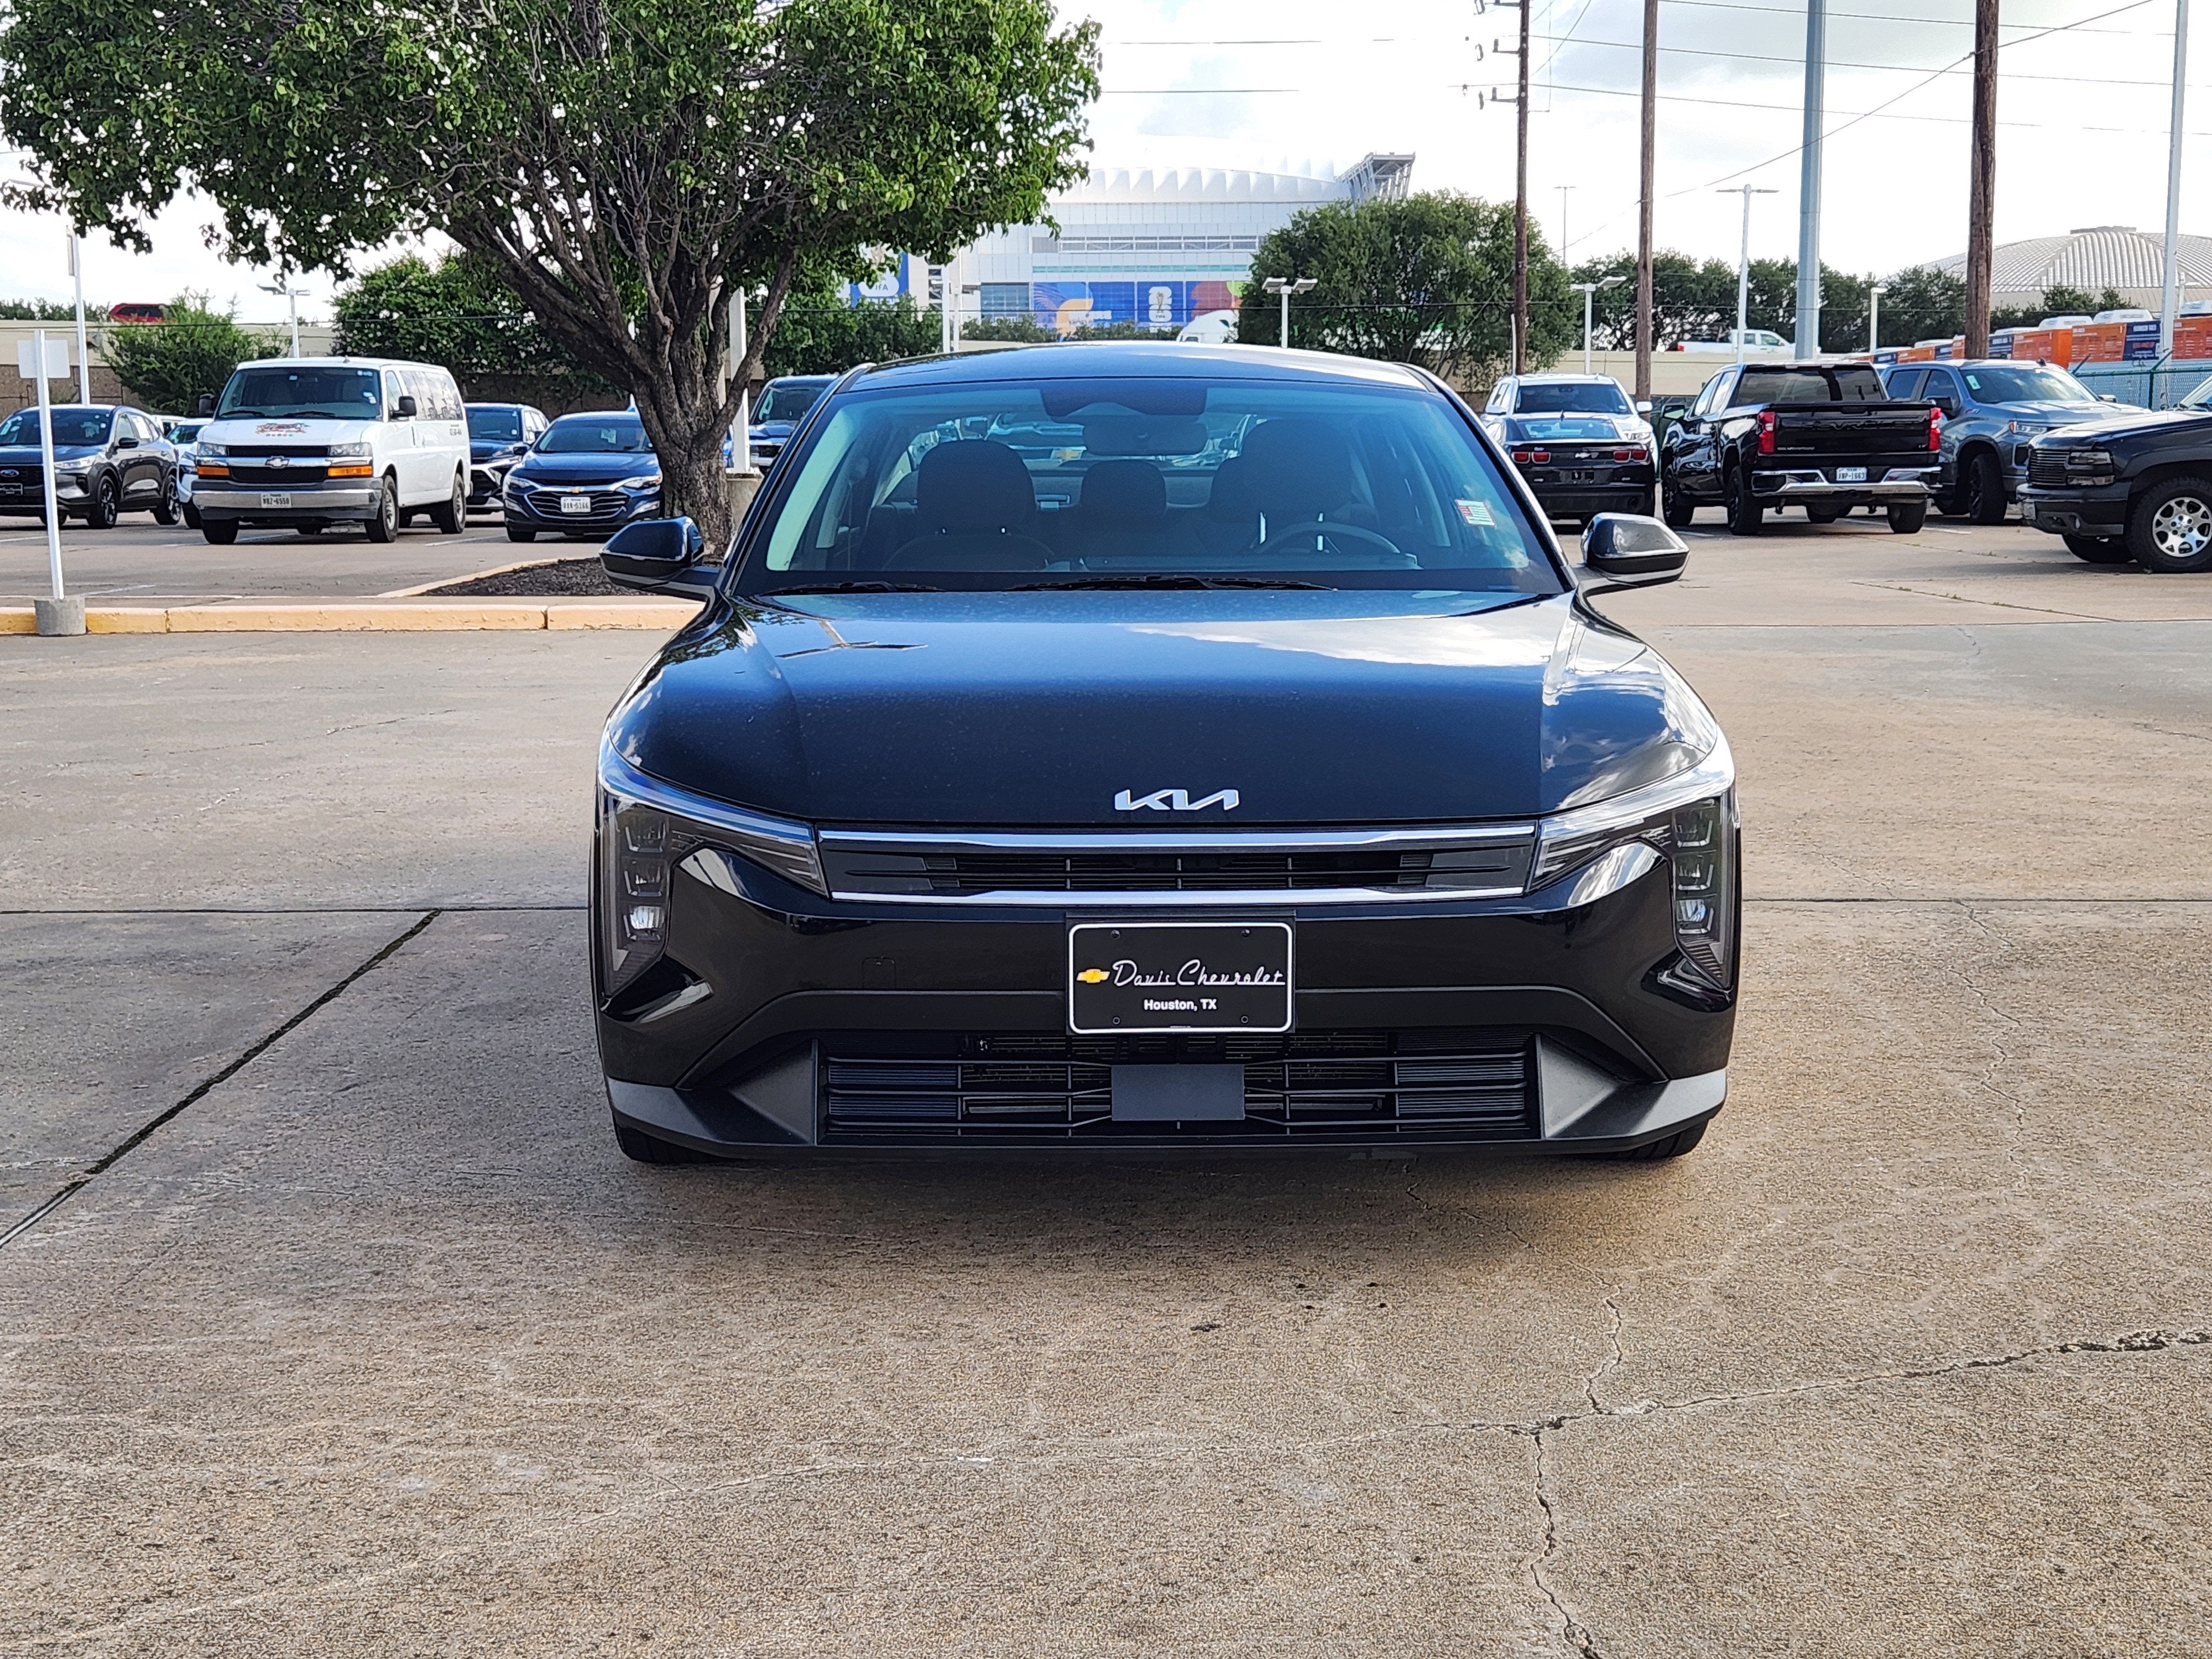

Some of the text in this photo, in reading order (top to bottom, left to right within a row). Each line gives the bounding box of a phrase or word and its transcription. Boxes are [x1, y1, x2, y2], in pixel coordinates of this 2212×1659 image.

[1114, 789, 1239, 811] KIA
[1112, 959, 1286, 987] Davis Chevrolet
[1144, 998, 1217, 1011] Houston, TX
